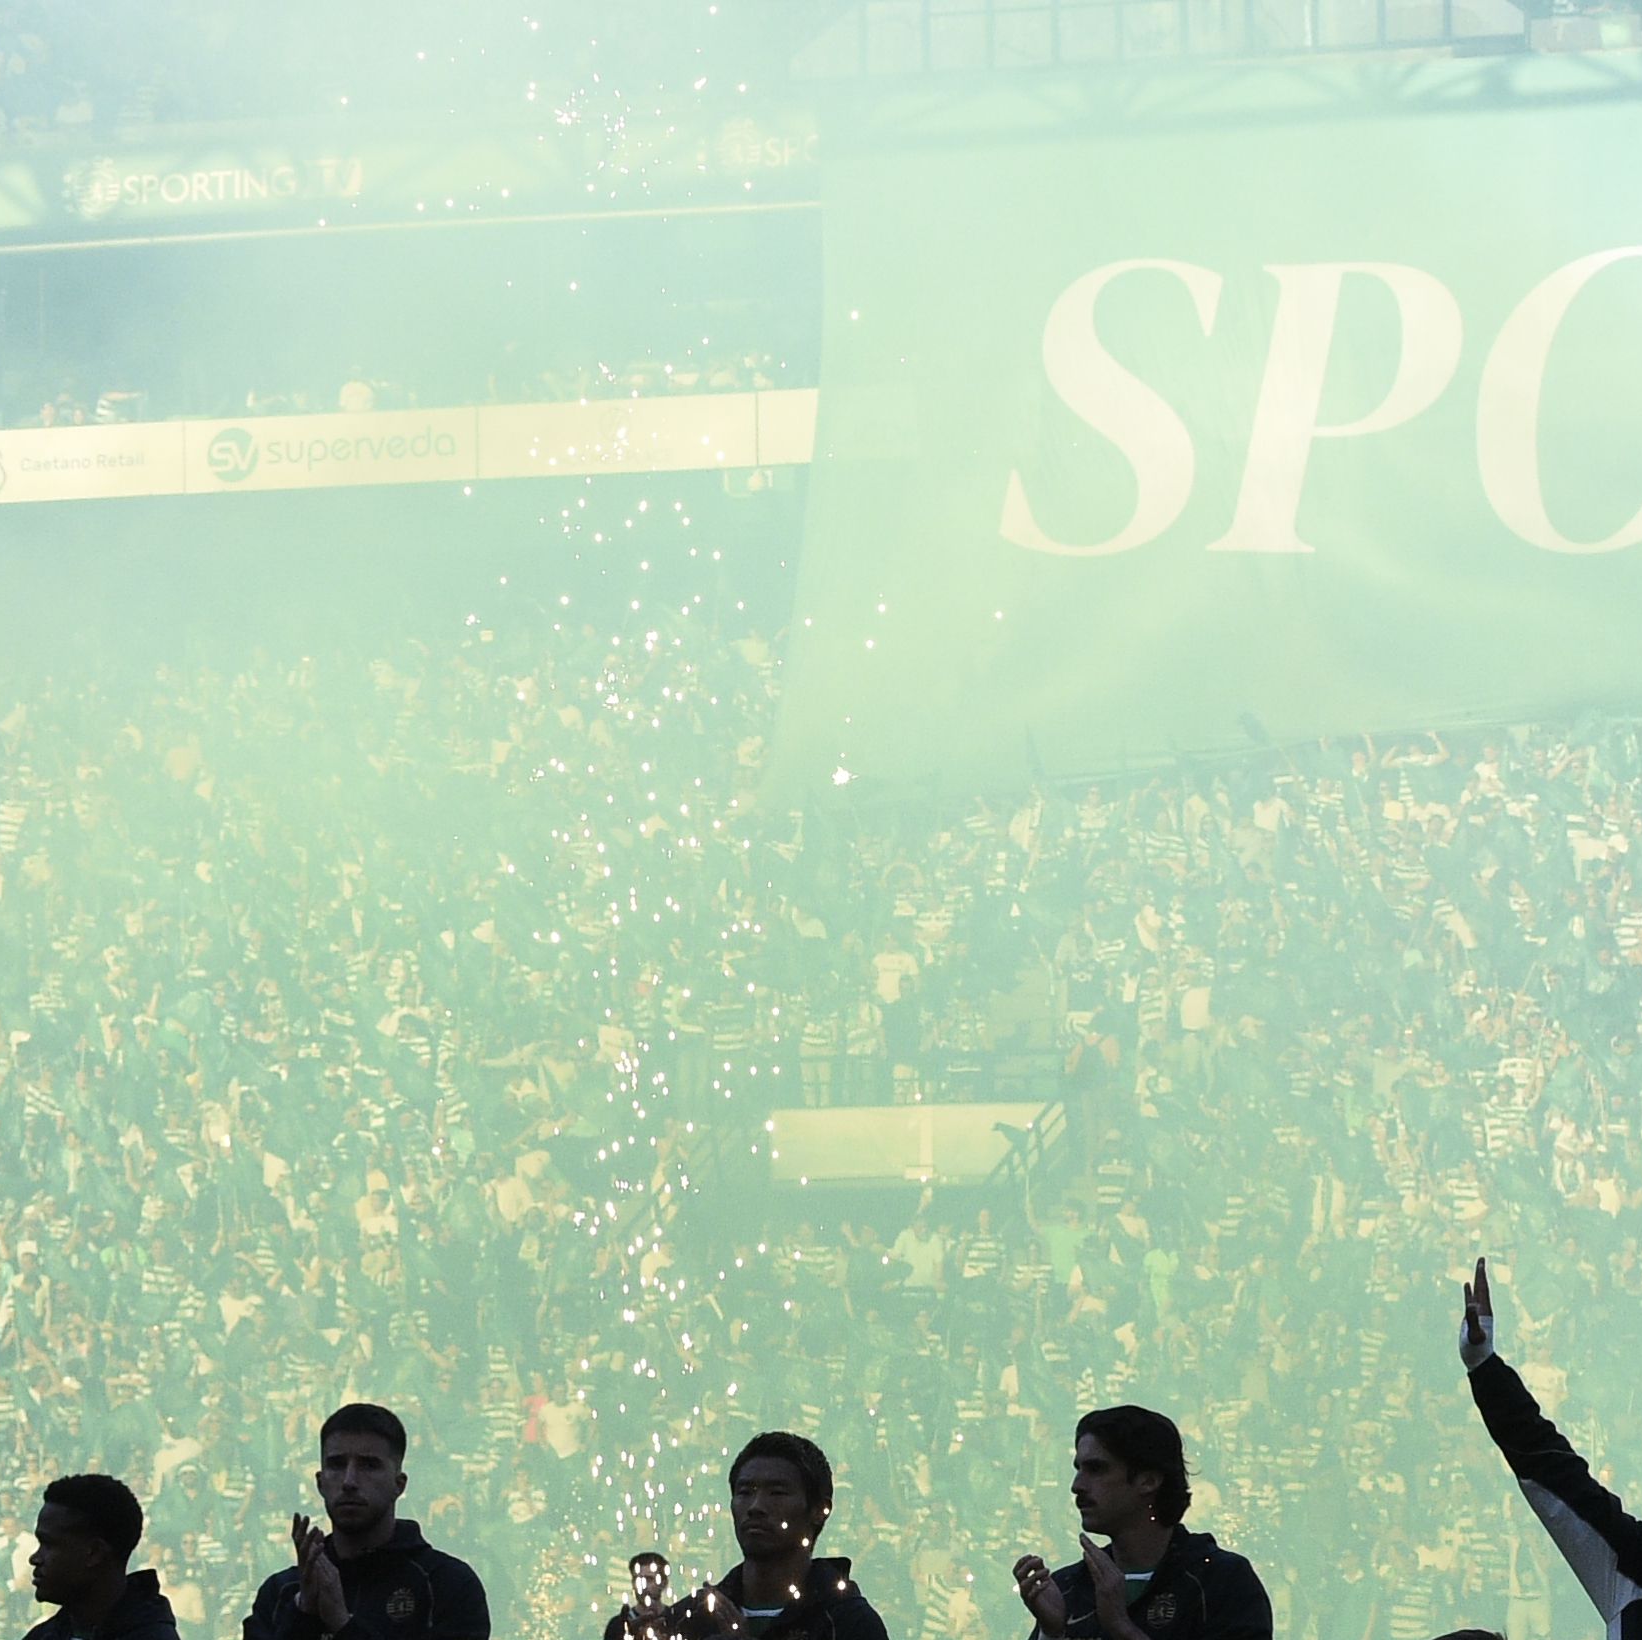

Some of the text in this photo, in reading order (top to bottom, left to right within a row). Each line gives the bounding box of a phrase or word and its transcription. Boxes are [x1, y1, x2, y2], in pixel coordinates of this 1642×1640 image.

[122, 164, 297, 206] SPORTING
[19, 451, 147, 473] Caetano Retail
[266, 425, 457, 472] superveda
